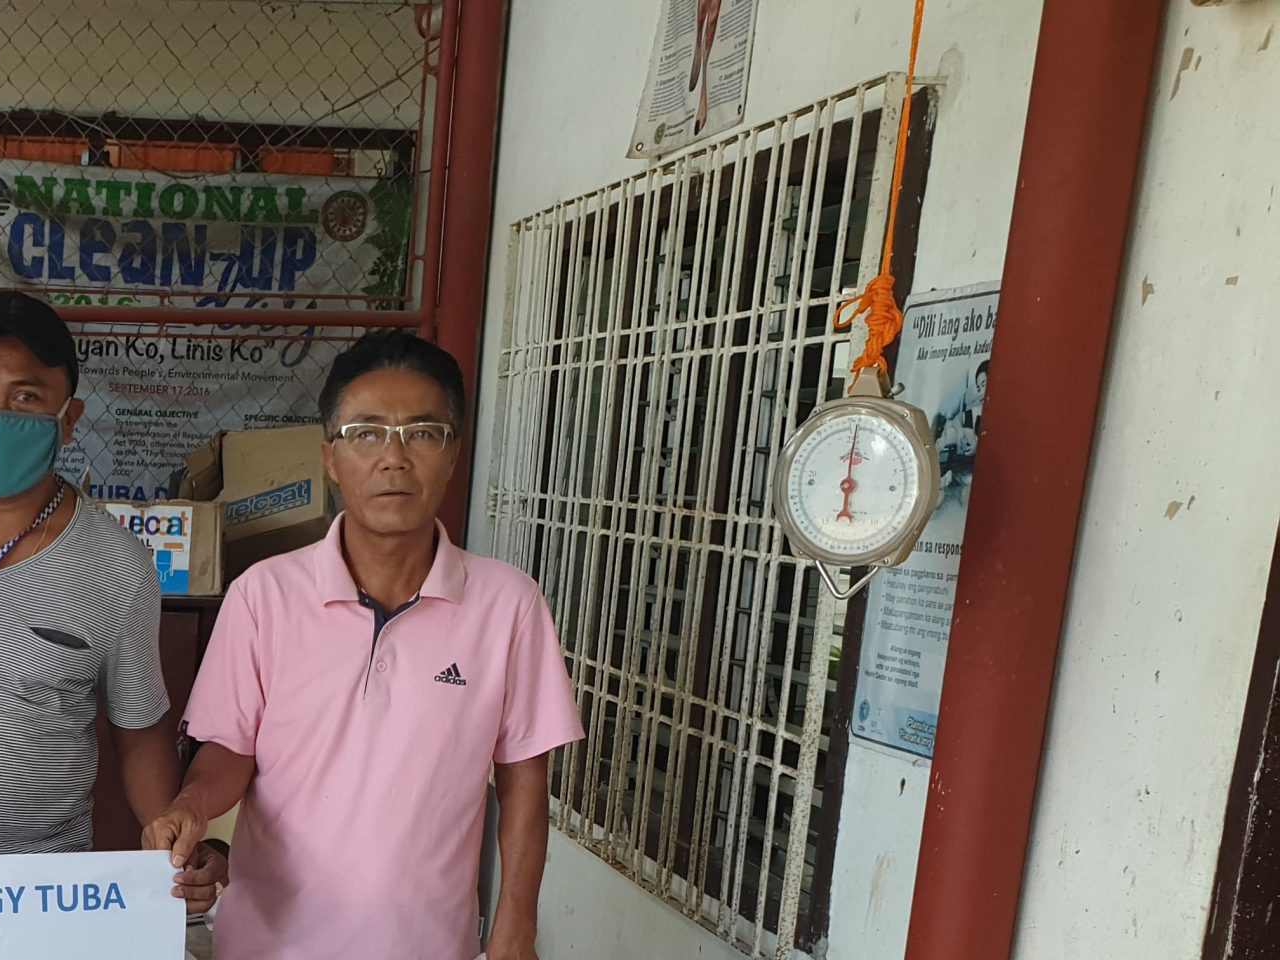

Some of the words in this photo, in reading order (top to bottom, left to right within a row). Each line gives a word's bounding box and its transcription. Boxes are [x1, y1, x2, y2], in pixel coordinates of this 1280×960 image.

[13, 174, 319, 223] NATIONAL
[937, 312, 961, 342] lang
[962, 307, 983, 333] ako
[73, 338, 119, 363] yan
[125, 337, 165, 364] Ko,
[171, 337, 223, 362] Linis
[916, 346, 929, 361] Ako
[928, 345, 948, 363] imong
[79, 364, 120, 376] Towards
[168, 368, 240, 381] Environmental
[241, 371, 295, 383] Movement
[108, 383, 169, 396] SEPTEMBER
[184, 385, 210, 396] 2016
[115, 408, 153, 417] GENERAL
[155, 409, 199, 419] OBJECTIVE
[244, 414, 280, 423] SPECIFIC
[114, 439, 126, 447] Act
[112, 458, 135, 467] Waste
[89, 485, 147, 501] TUBA
[925, 544, 933, 553] sa
[434, 675, 467, 686] adidas
[35, 881, 126, 912] TUBA
